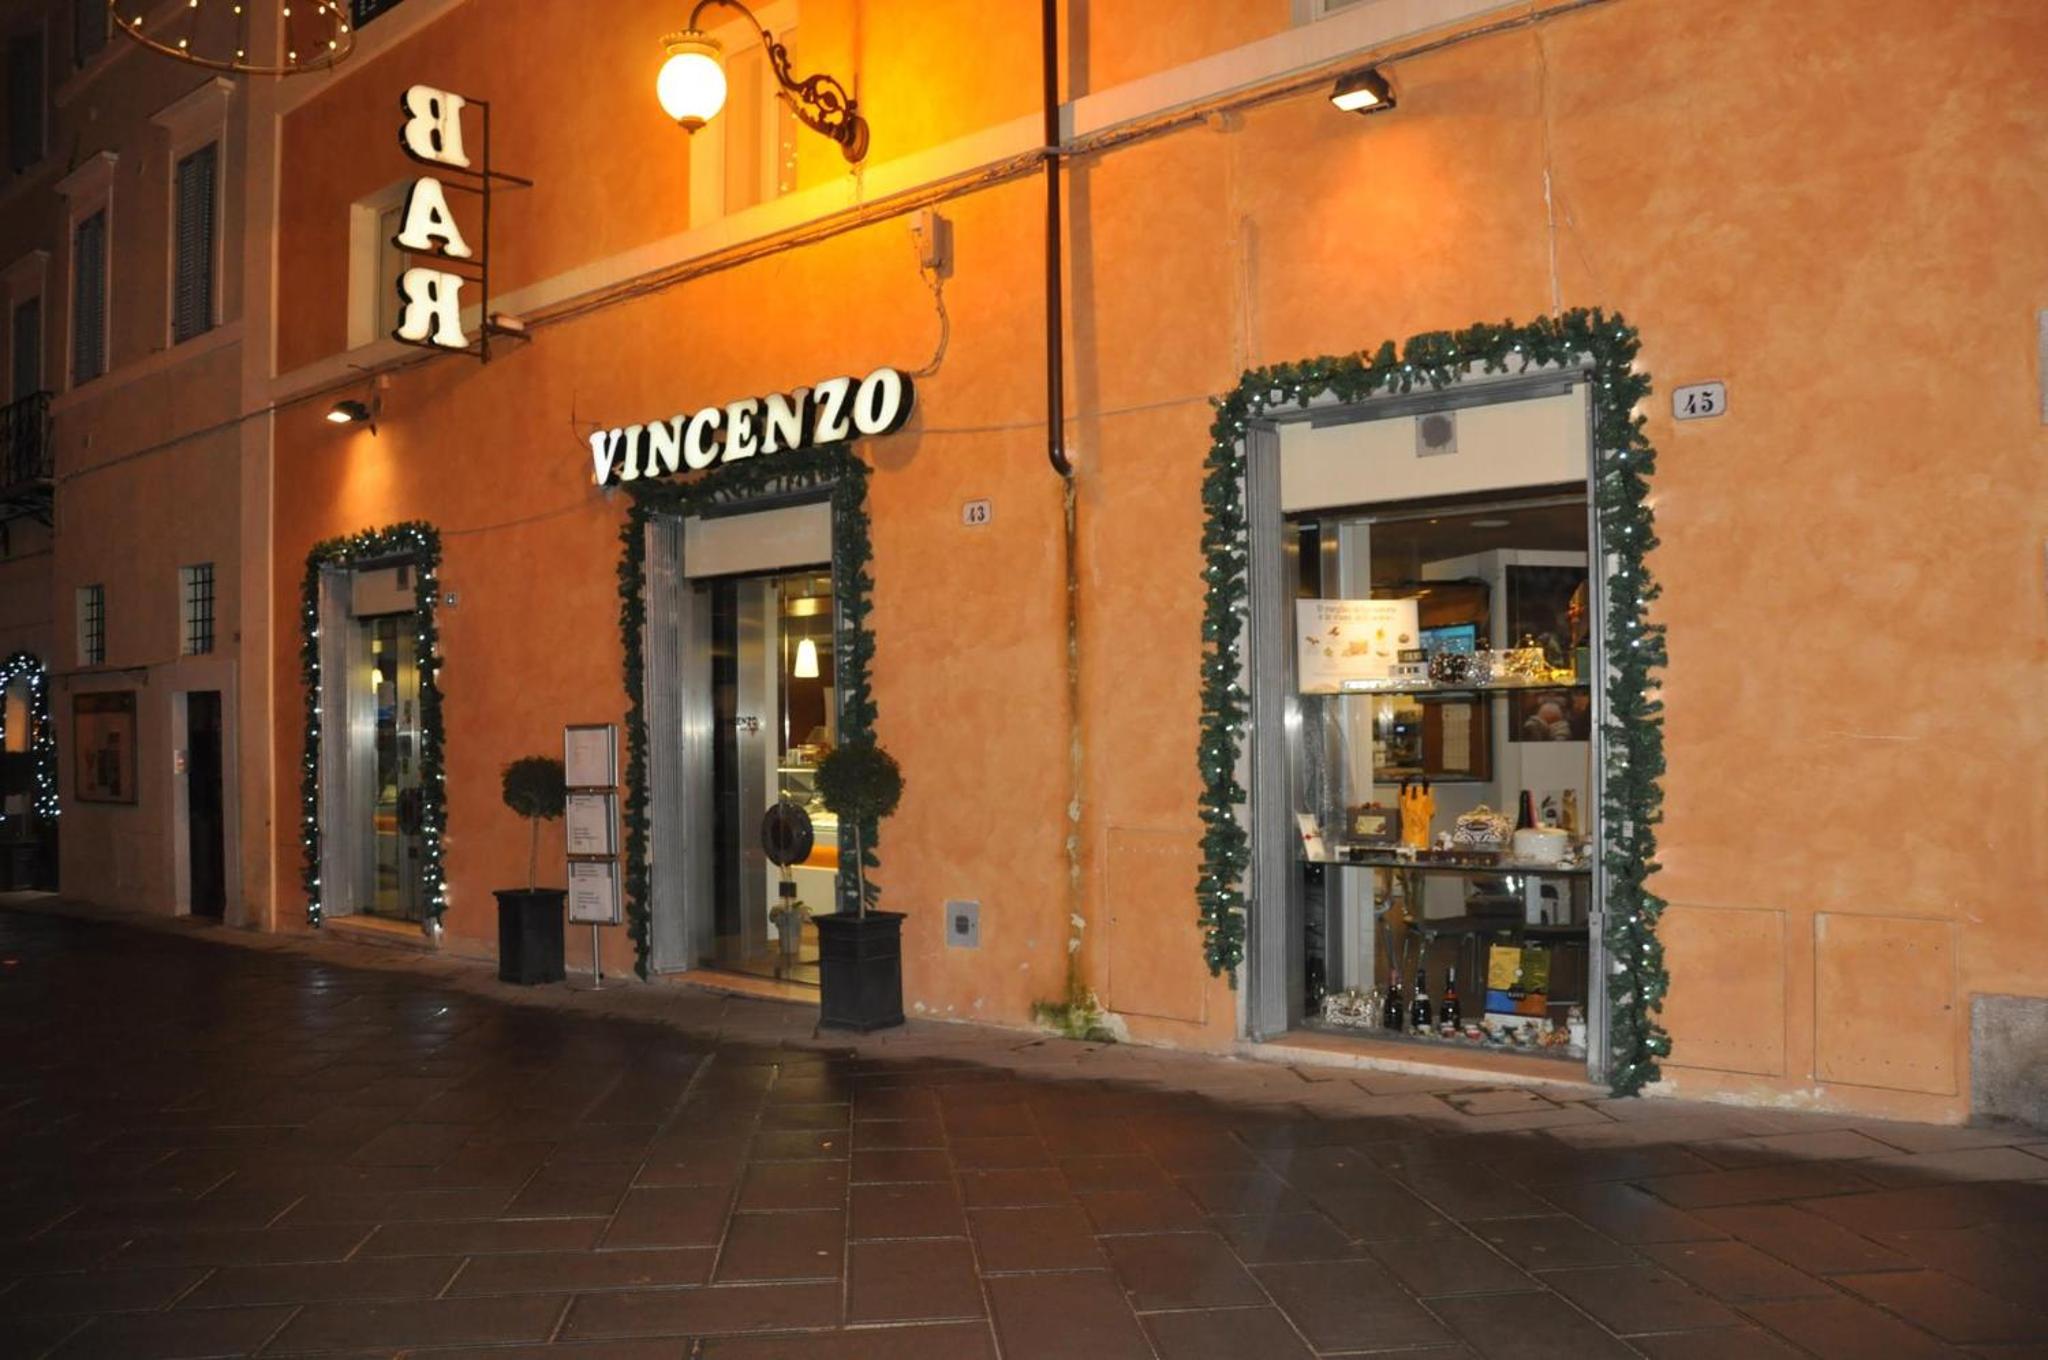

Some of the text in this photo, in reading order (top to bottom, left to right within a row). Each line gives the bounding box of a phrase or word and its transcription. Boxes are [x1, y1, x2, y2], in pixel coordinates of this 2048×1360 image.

[1683, 390, 1714, 415] 45
[589, 366, 902, 485] VINCENZO
[967, 505, 985, 522] 43
